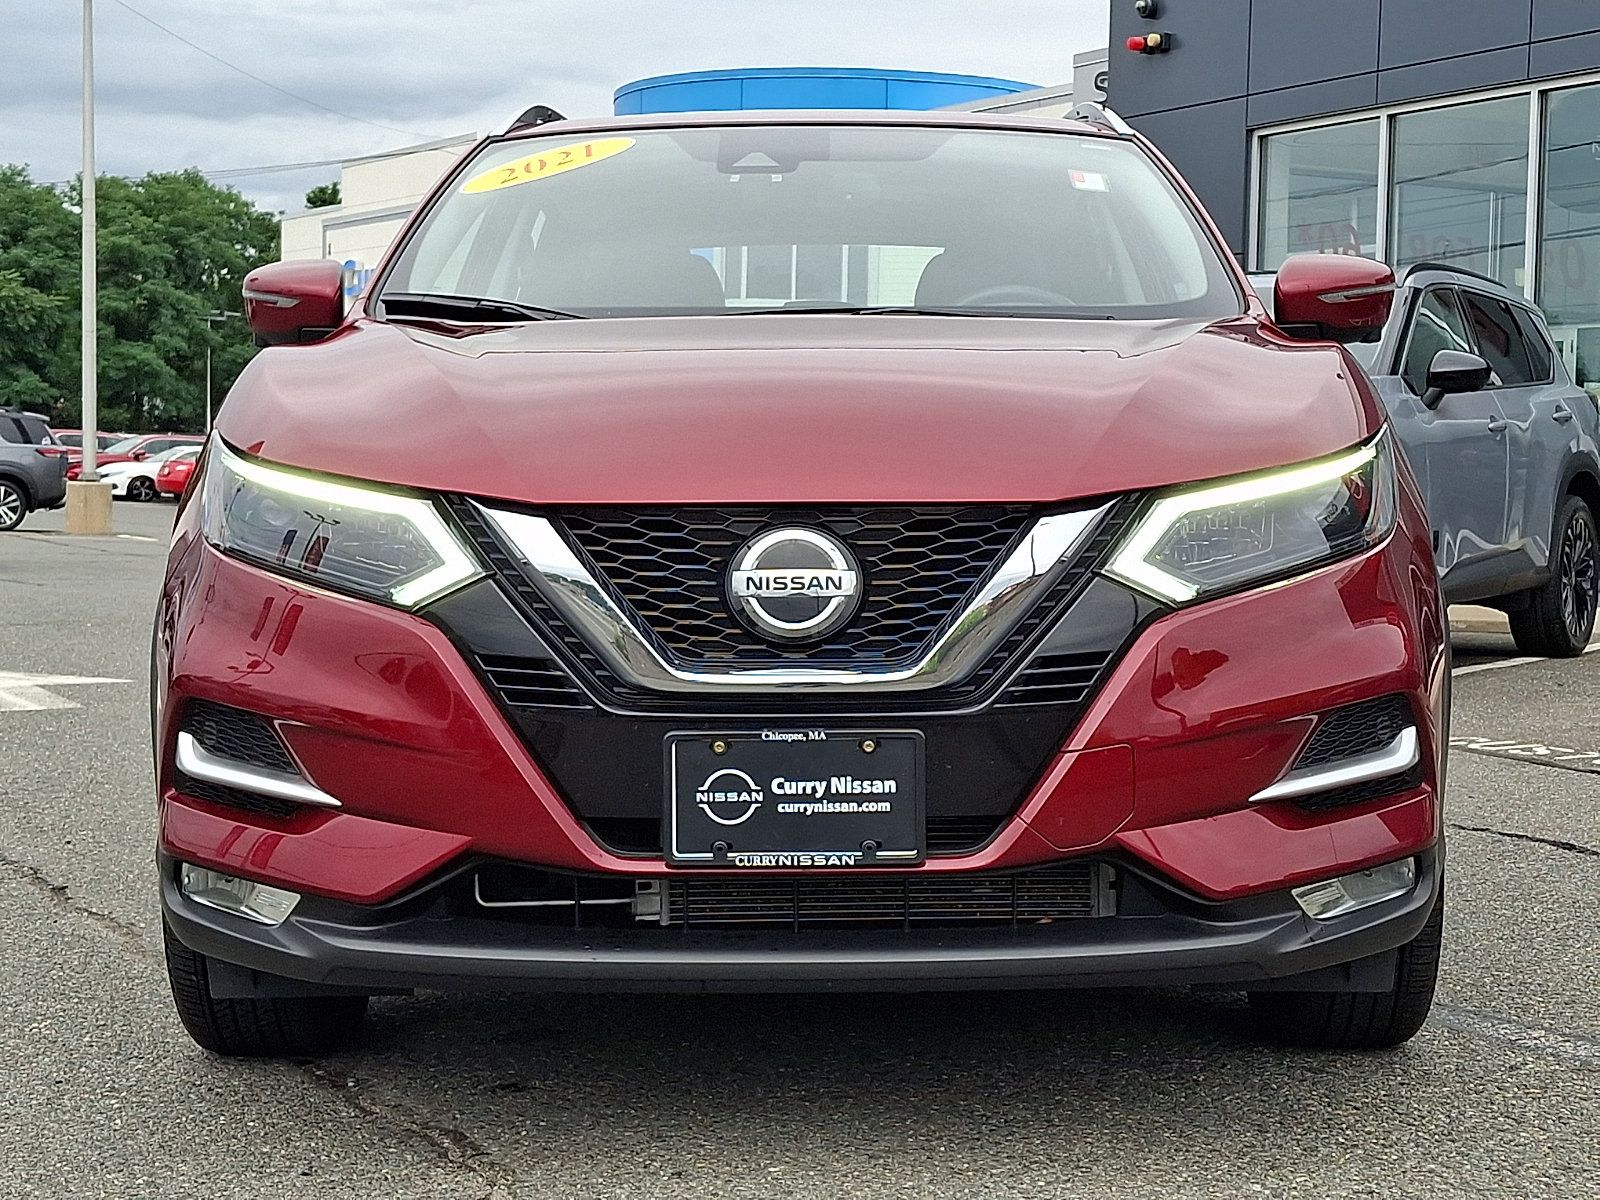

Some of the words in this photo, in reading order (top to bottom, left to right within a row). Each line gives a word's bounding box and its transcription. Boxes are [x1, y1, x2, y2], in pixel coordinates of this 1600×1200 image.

[500, 144, 593, 185] 2021
[745, 576, 842, 591] NISSAN
[808, 730, 827, 741] MA
[771, 777, 827, 799] Curry
[830, 776, 897, 794] Nissan
[695, 791, 764, 803] NISSAN
[777, 800, 891, 816] currynissan.com
